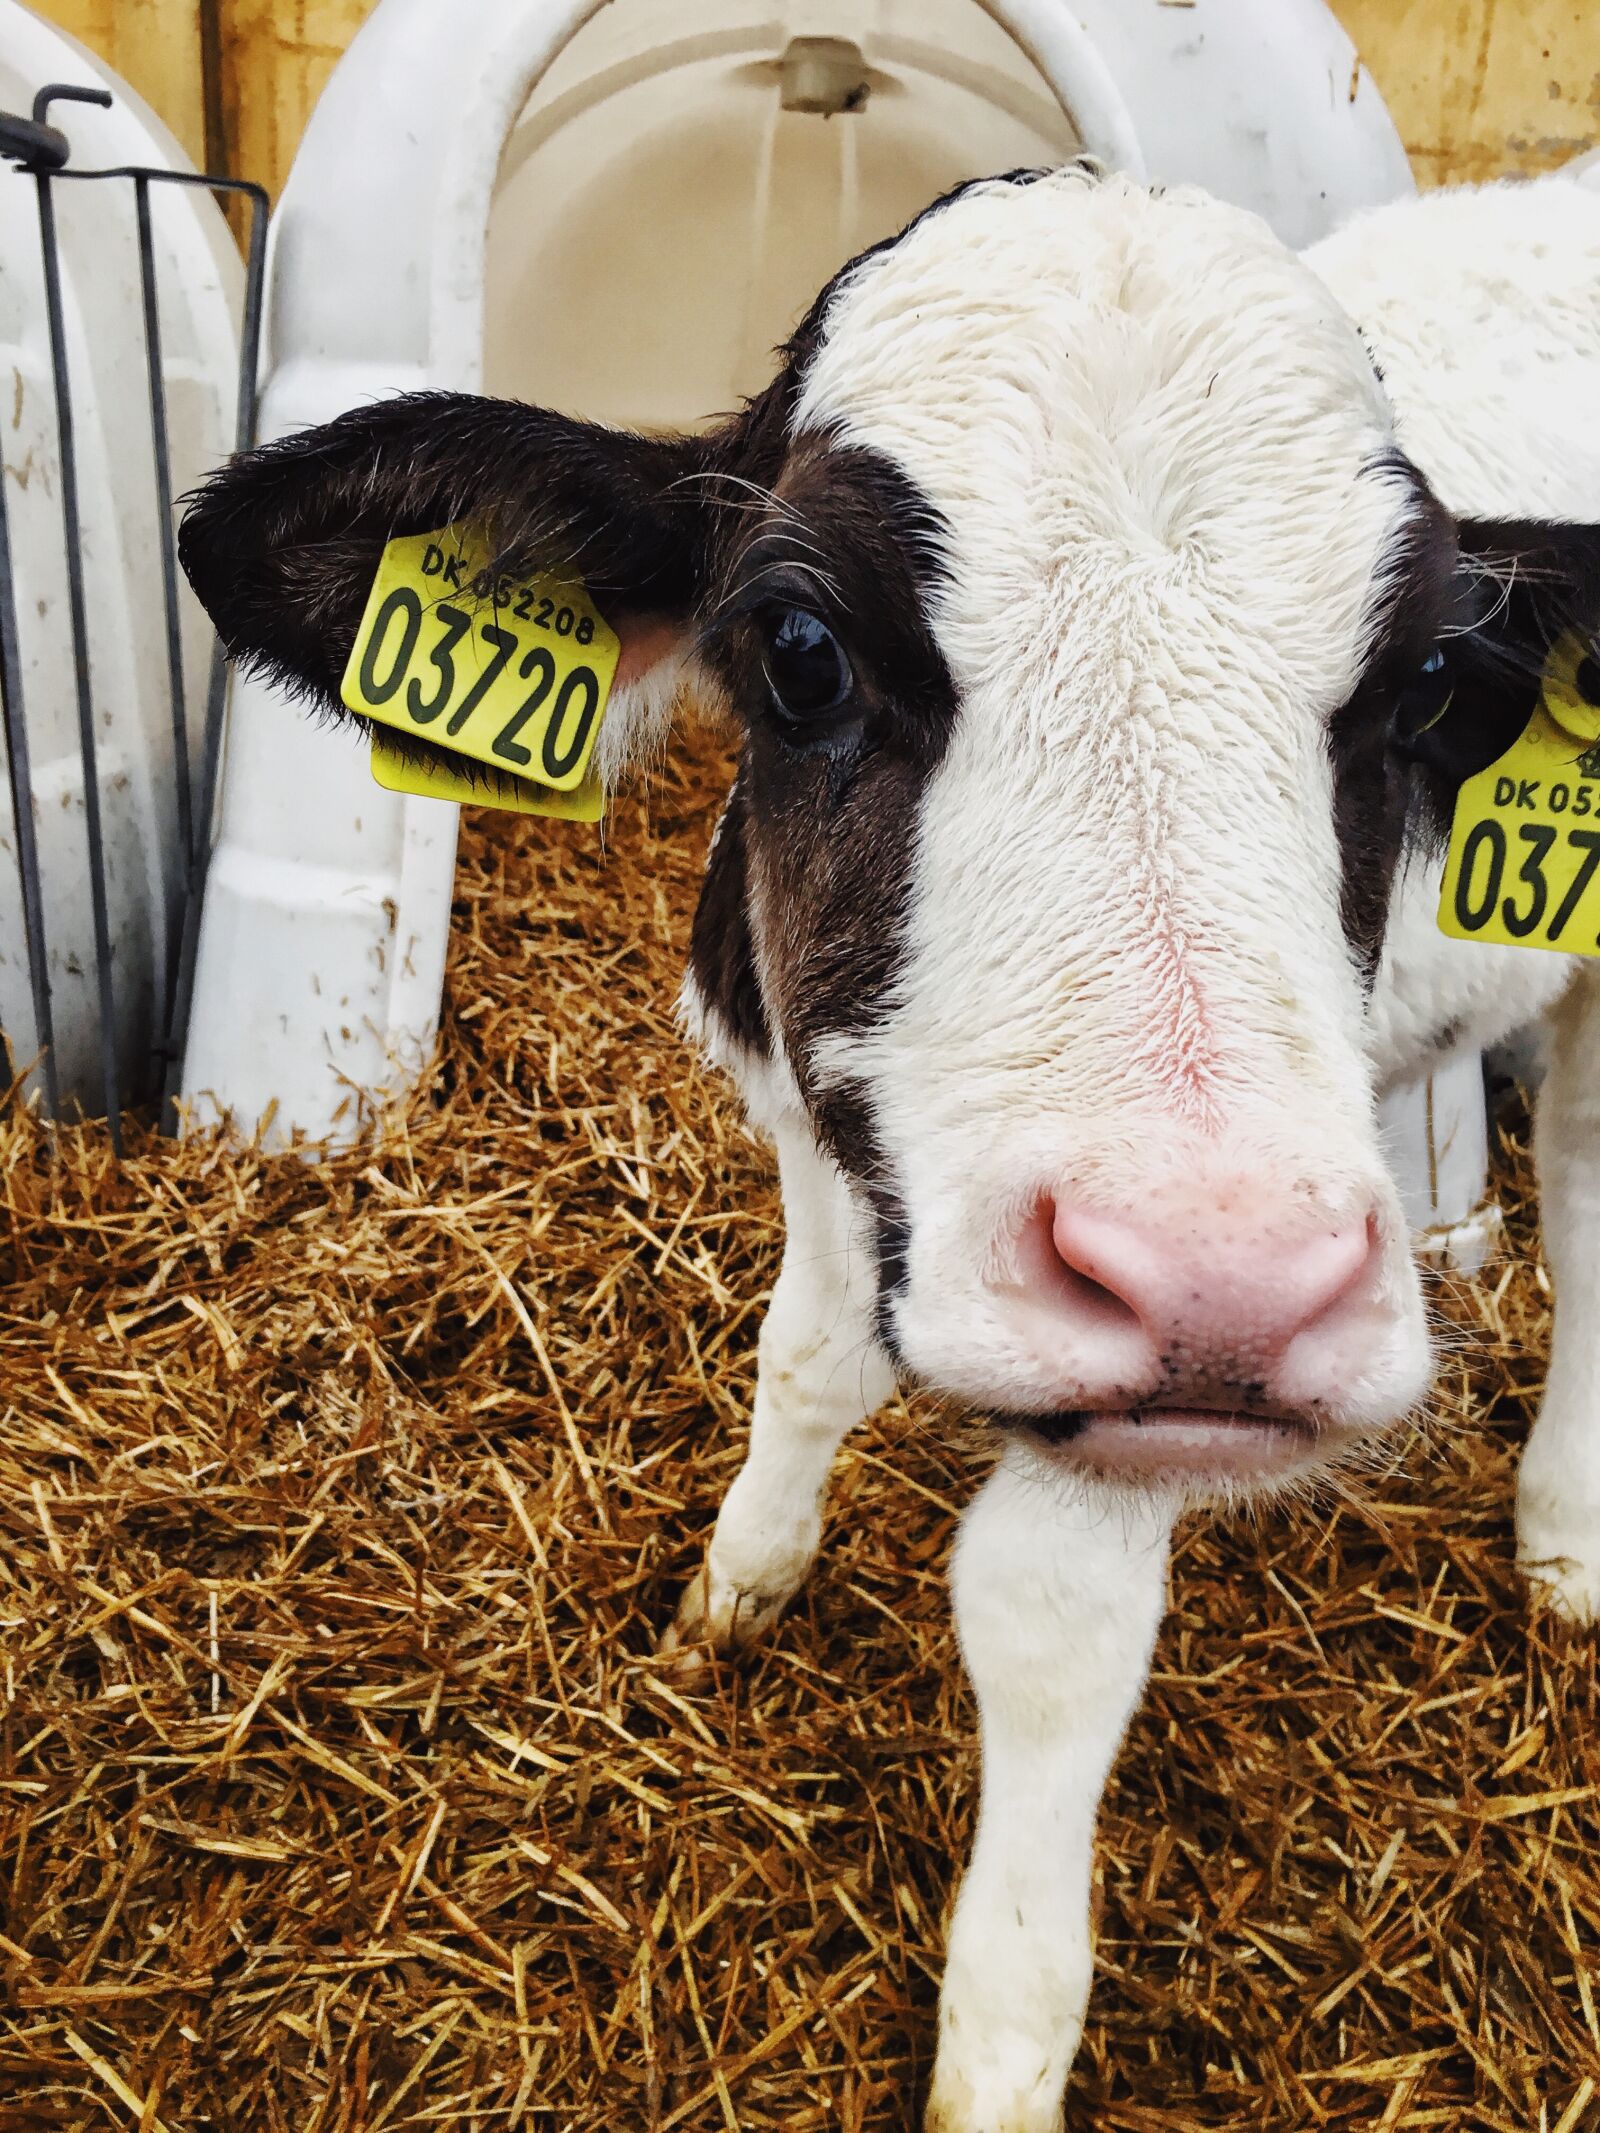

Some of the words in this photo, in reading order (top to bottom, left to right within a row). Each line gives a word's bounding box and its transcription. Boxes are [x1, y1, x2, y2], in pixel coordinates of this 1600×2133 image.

[421, 544, 467, 589] DK
[360, 587, 599, 778] 03720
[1494, 776, 1541, 811] DK
[1548, 783, 1600, 819] 05
[1455, 818, 1600, 948] 037
